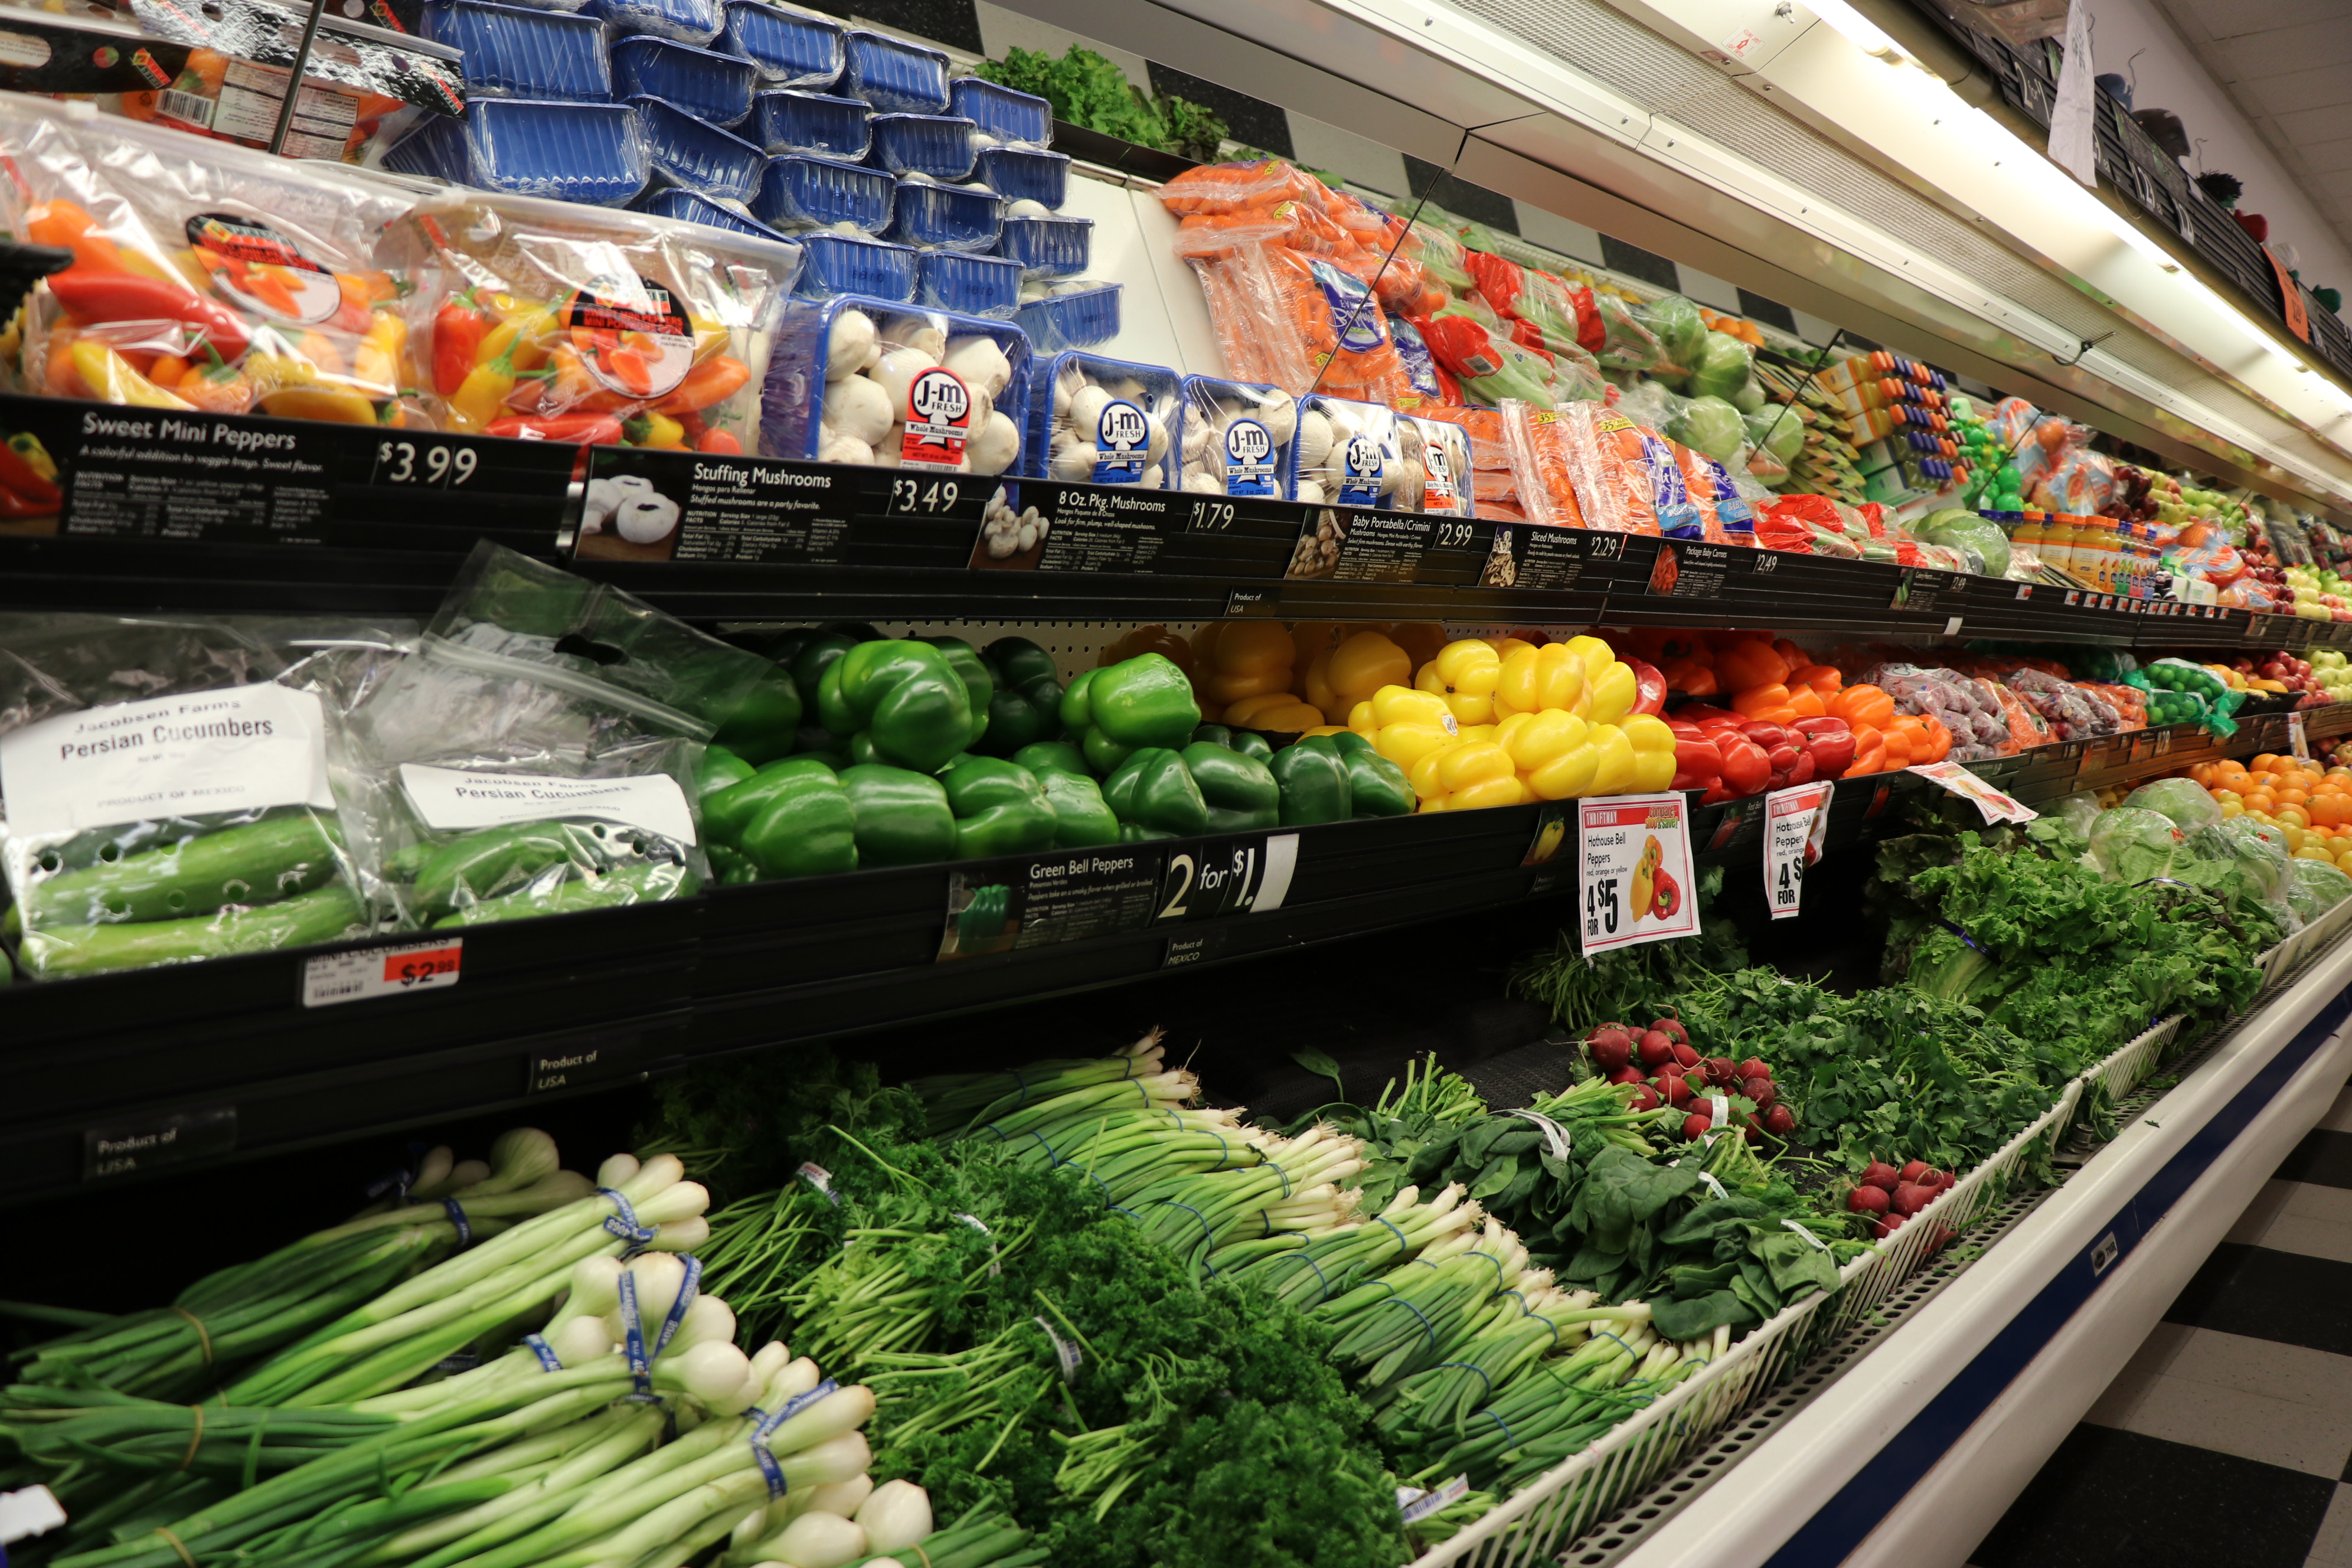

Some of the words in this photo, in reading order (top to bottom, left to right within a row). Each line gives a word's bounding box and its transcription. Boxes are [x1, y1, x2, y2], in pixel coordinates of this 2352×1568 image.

[932, 402, 962, 413] FRESH
[1539, 414, 1550, 422] 35
[1603, 421, 1614, 430] 35
[83, 411, 154, 439] Sweet
[159, 419, 207, 443] Mini
[213, 423, 297, 452] Peppers
[910, 423, 929, 433] Whole
[929, 426, 963, 436] Mushrooms
[79, 444, 90, 456] A
[196, 455, 231, 468] veggie
[262, 458, 292, 471] Sweet
[381, 442, 478, 484] $3.99
[694, 463, 749, 487] Stuffing
[752, 467, 831, 489] Mushrooms
[692, 484, 716, 494] Hongos
[717, 486, 731, 495] para
[894, 479, 958, 513] $3.49
[690, 494, 717, 505] Stuffed
[717, 497, 756, 506] mushrooms
[774, 499, 793, 510] party
[793, 499, 821, 510] favorite.
[1059, 491, 1067, 505] 8
[1069, 492, 1087, 507] Oz.
[1089, 494, 1109, 512] Pkg.
[1110, 495, 1166, 512] Mushrooms
[1074, 509, 1092, 517] Paquete
[1193, 501, 1235, 530] $1.79
[1067, 518, 1076, 526] for
[1104, 520, 1132, 529] well-shaped
[1353, 515, 1371, 530] Baby
[1371, 517, 1431, 532] Portabella/Crimini
[1350, 528, 1376, 537] Mushrooms
[1439, 523, 1473, 547] $2.99
[1531, 531, 1547, 542] Sliced
[1547, 533, 1577, 545] Mushrooms
[1592, 536, 1616, 557] $2.29
[1686, 545, 1702, 558] Package
[1702, 547, 1713, 558] Baby
[1713, 548, 1727, 558] Carrots
[1234, 592, 1253, 602] Product
[1255, 593, 1262, 602] of
[1230, 605, 1244, 614] USA
[75, 710, 171, 734] Jacobsen
[178, 698, 242, 715] Farms
[60, 732, 144, 760] Persian
[152, 717, 275, 744] Cucumbers
[465, 776, 542, 787] Jacobsen
[97, 791, 166, 809] PRODUCT
[169, 789, 188, 799] OF
[191, 784, 246, 798] MEXICO
[455, 786, 527, 799] Persian
[530, 785, 632, 801] Cucumbers
[1585, 810, 1618, 827] THRIFTWAY
[1776, 819, 1802, 834] Hothouse
[1587, 834, 1614, 848] Hothouse
[1615, 832, 1626, 845] Bell
[1776, 834, 1804, 849] Peppers
[1587, 852, 1611, 868] Peppers
[1788, 847, 1805, 857] orange
[1030, 863, 1065, 879] Green
[1069, 858, 1089, 875] Bell
[1092, 857, 1133, 875] Peppers
[1595, 868, 1611, 877] orange
[1615, 865, 1628, 874] yellow
[1779, 863, 1791, 889] 4
[1028, 892, 1048, 900] Peppers
[1049, 890, 1060, 899] take
[1072, 888, 1087, 896] smoky
[1087, 886, 1102, 895] flavor
[1115, 880, 1131, 891] grilled
[1158, 854, 1195, 919] 2
[1199, 863, 1229, 890] for
[1587, 885, 1595, 917] 4
[1778, 889, 1796, 905] FOR
[1587, 918, 1599, 936] FOR
[1172, 940, 1195, 952] Product
[1195, 938, 1203, 949] of
[1167, 952, 1200, 965] MEXICO
[540, 1055, 583, 1071] Product
[586, 1050, 598, 1063] of
[537, 1074, 566, 1090] USA
[97, 1135, 157, 1155] Product
[160, 1127, 177, 1145] of
[97, 1157, 136, 1177] USA
[2105, 1240, 2117, 1257] TYLER
